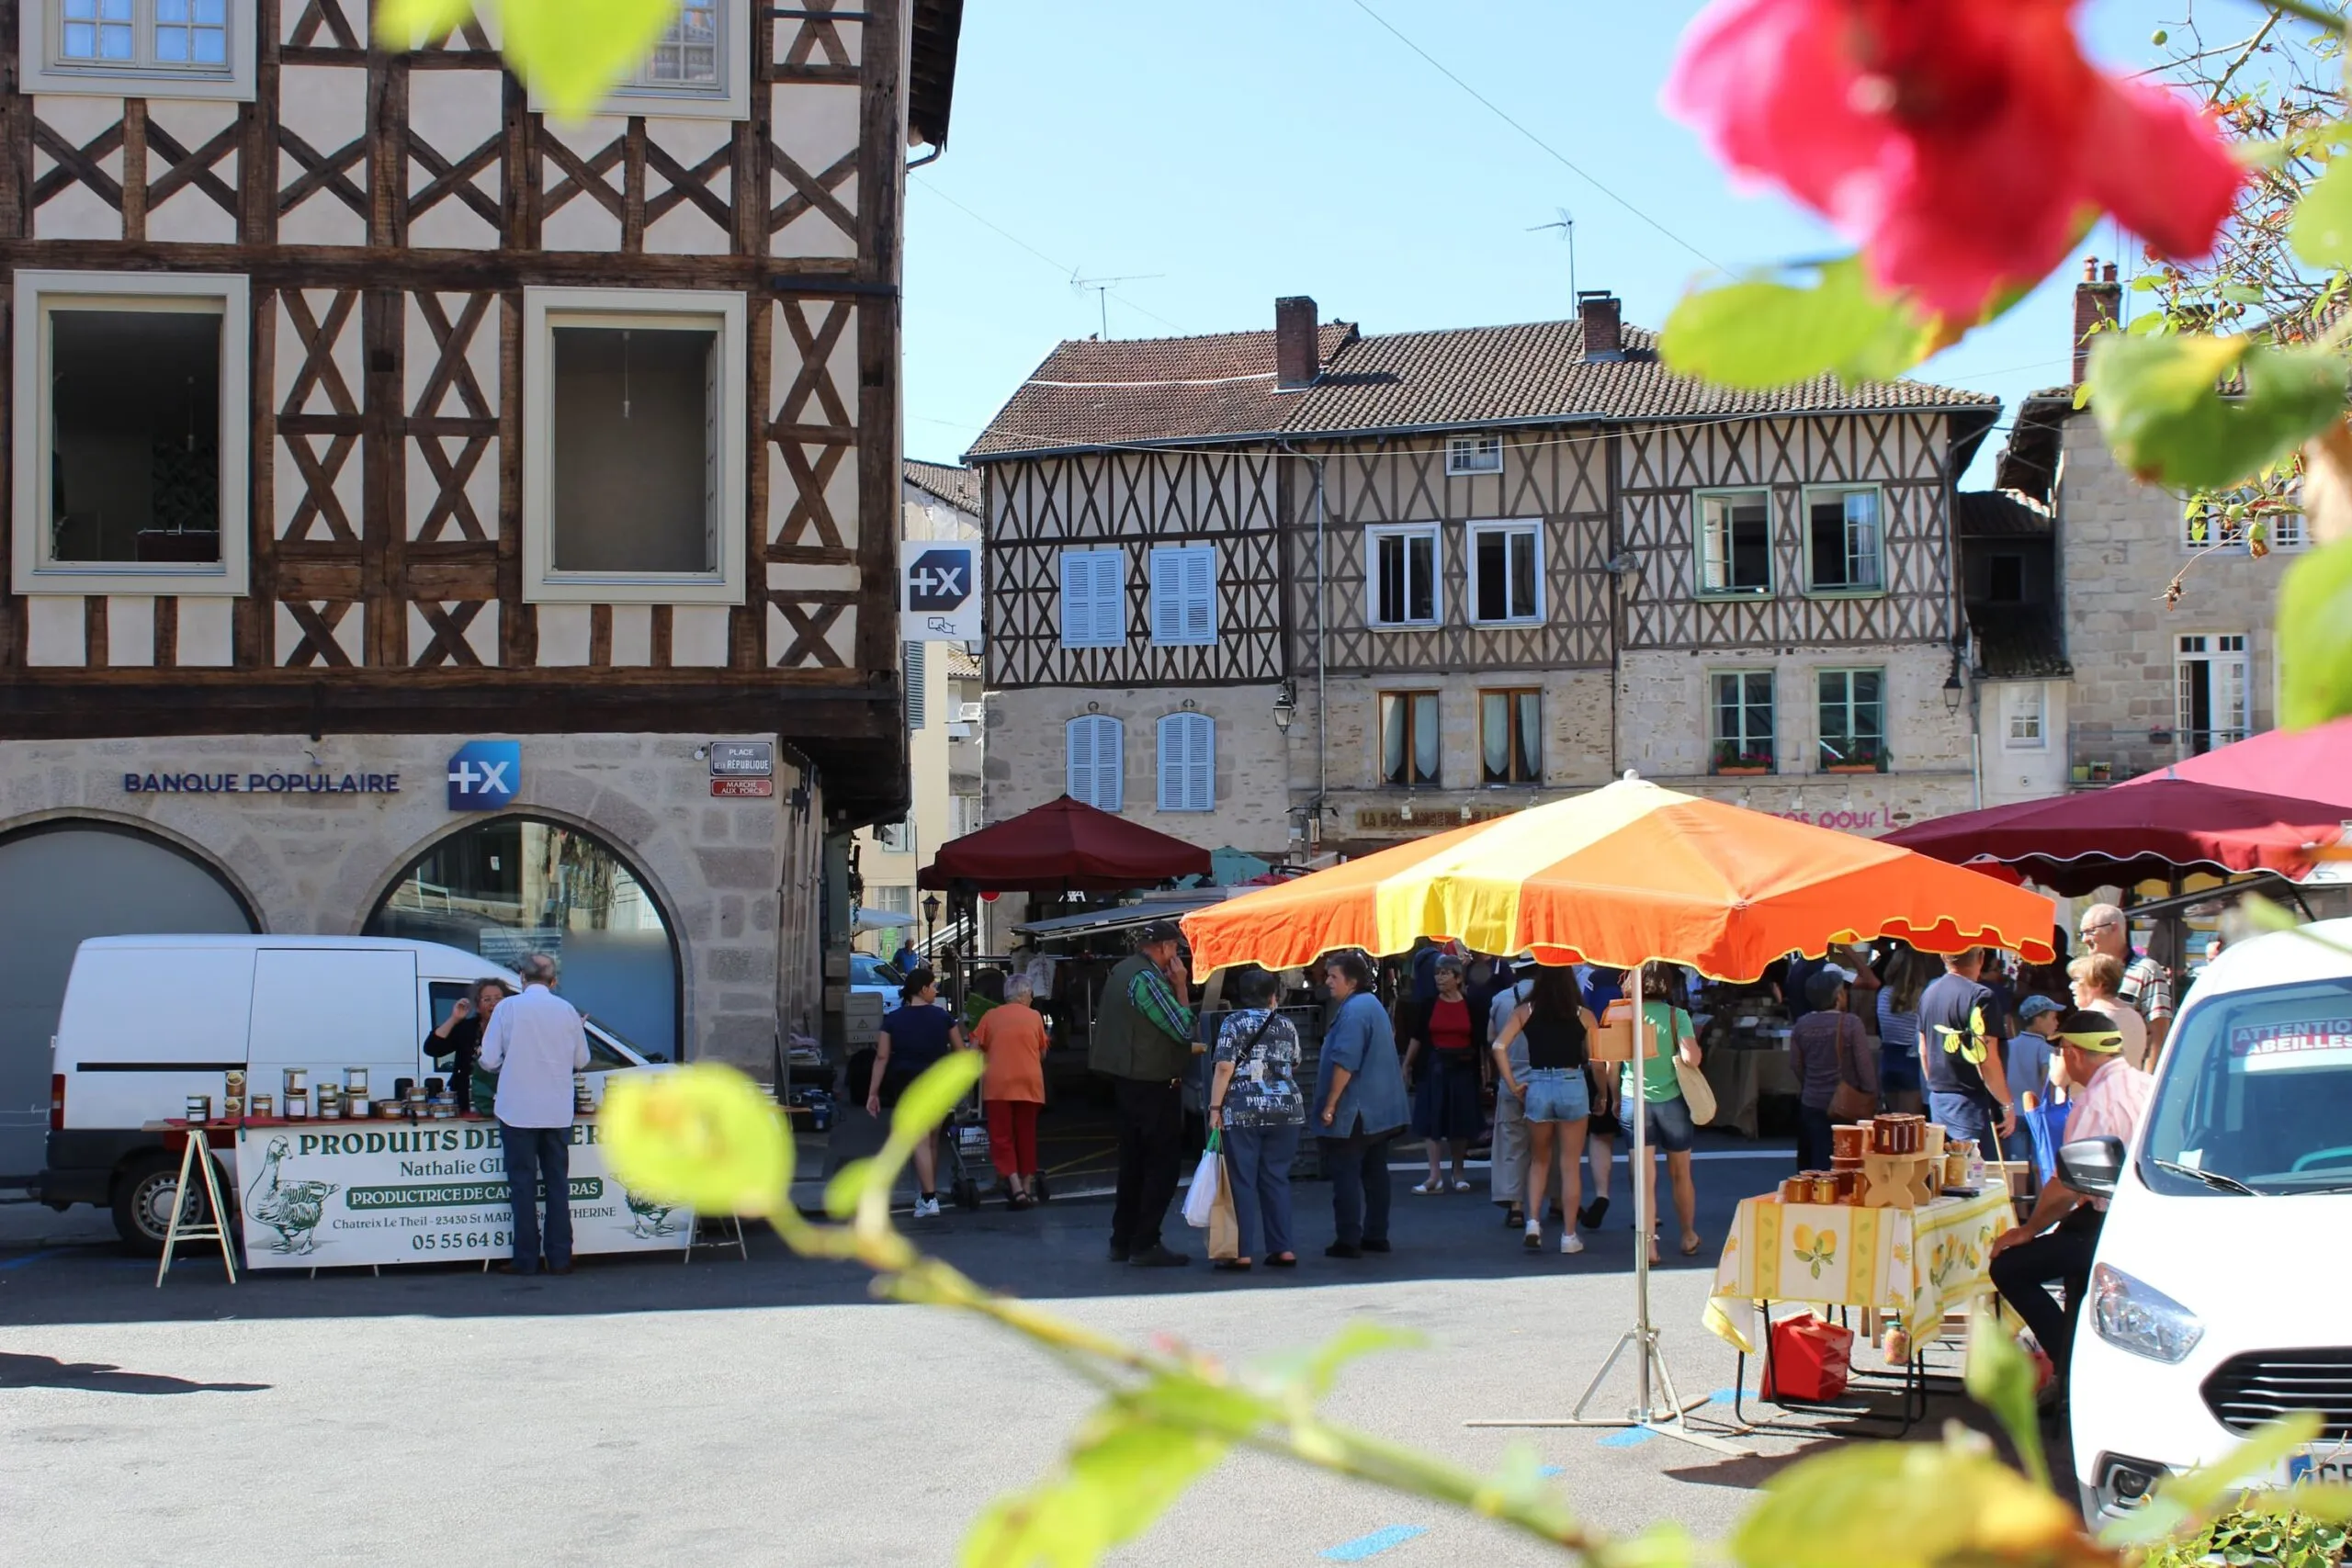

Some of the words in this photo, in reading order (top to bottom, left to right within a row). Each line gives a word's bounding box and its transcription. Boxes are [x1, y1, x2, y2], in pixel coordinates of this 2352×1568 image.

[124, 773, 239, 793] BANQUE
[247, 773, 401, 793] POPULAIRE
[1362, 812, 1376, 827] LA
[1818, 811, 1877, 829] pour
[2247, 1034, 2352, 1055] ABEILLES
[300, 1129, 458, 1155] PRODUITS
[465, 1128, 501, 1149] DE
[401, 1158, 476, 1177] Nathalie
[352, 1187, 462, 1204] PRODUCTRICE
[463, 1187, 483, 1201] DE
[333, 1218, 381, 1230] Chatreix
[384, 1217, 397, 1227] Le
[399, 1215, 427, 1227] Theil
[435, 1214, 468, 1226] 23430
[469, 1213, 481, 1224] St
[413, 1234, 435, 1250] 05
[440, 1233, 462, 1249] 55
[466, 1231, 489, 1247] 64
